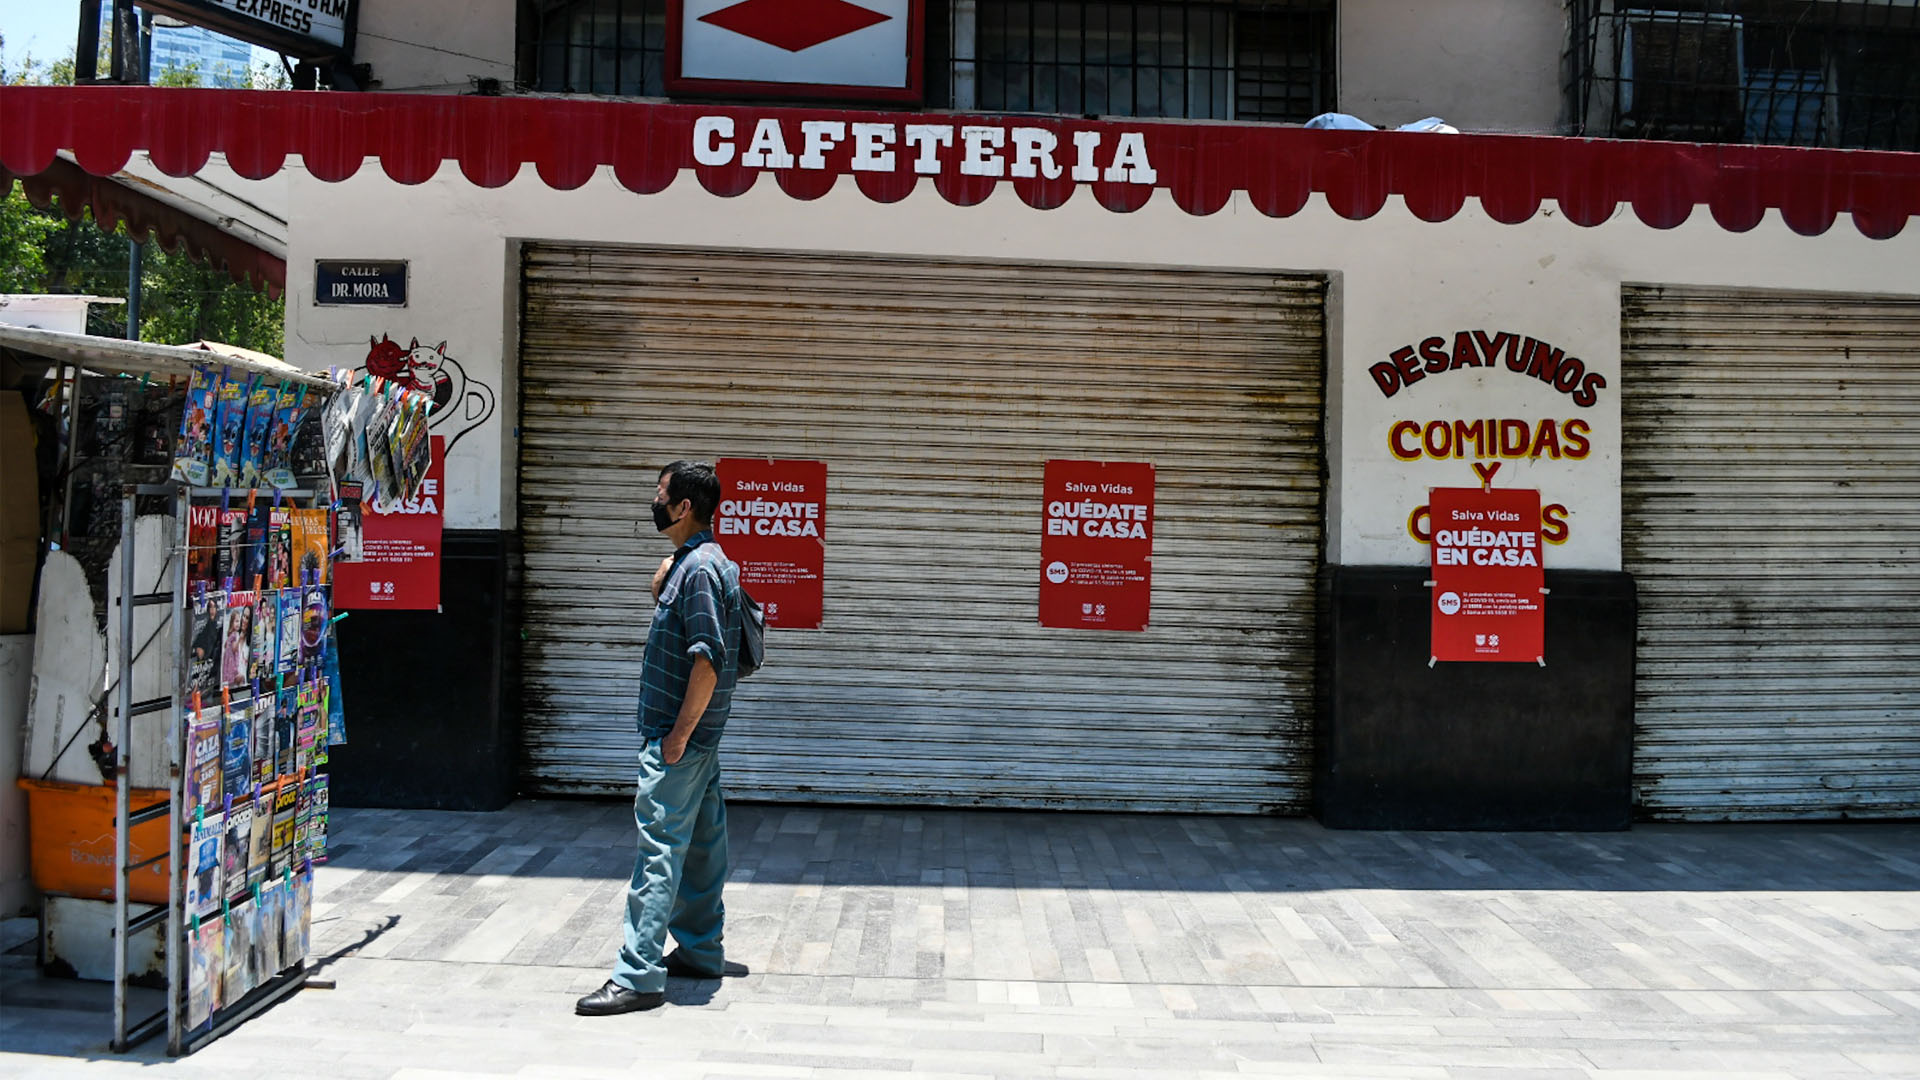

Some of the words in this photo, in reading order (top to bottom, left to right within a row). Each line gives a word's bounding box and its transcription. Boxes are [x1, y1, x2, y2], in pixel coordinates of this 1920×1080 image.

[235, 0, 313, 34] EXPRESS
[693, 115, 1158, 185] CAFETERIA
[341, 266, 381, 277] CALLE
[1368, 330, 1607, 408] DESAYUNOS
[1387, 418, 1592, 462] COMIDAS
[1471, 461, 1502, 489] Y
[736, 480, 769, 492] Salva
[773, 481, 805, 493] Vidas
[1065, 481, 1097, 493] Salva
[1100, 484, 1134, 495] Vidas
[719, 497, 819, 519] QUÉDATE
[1047, 498, 1148, 521] QUÉDATE
[1452, 509, 1484, 521] Salva
[1487, 510, 1520, 522] Vidas
[719, 518, 750, 535] EN
[754, 518, 819, 537] CASA
[1047, 519, 1079, 537] EN
[1083, 520, 1148, 540] CASA
[1435, 526, 1537, 548] QUÉDATE
[1436, 547, 1469, 566] EN
[1472, 548, 1538, 567] CASA
[1049, 568, 1067, 576] SMS
[1440, 599, 1458, 607] SMS
[195, 733, 220, 758] CAZA
